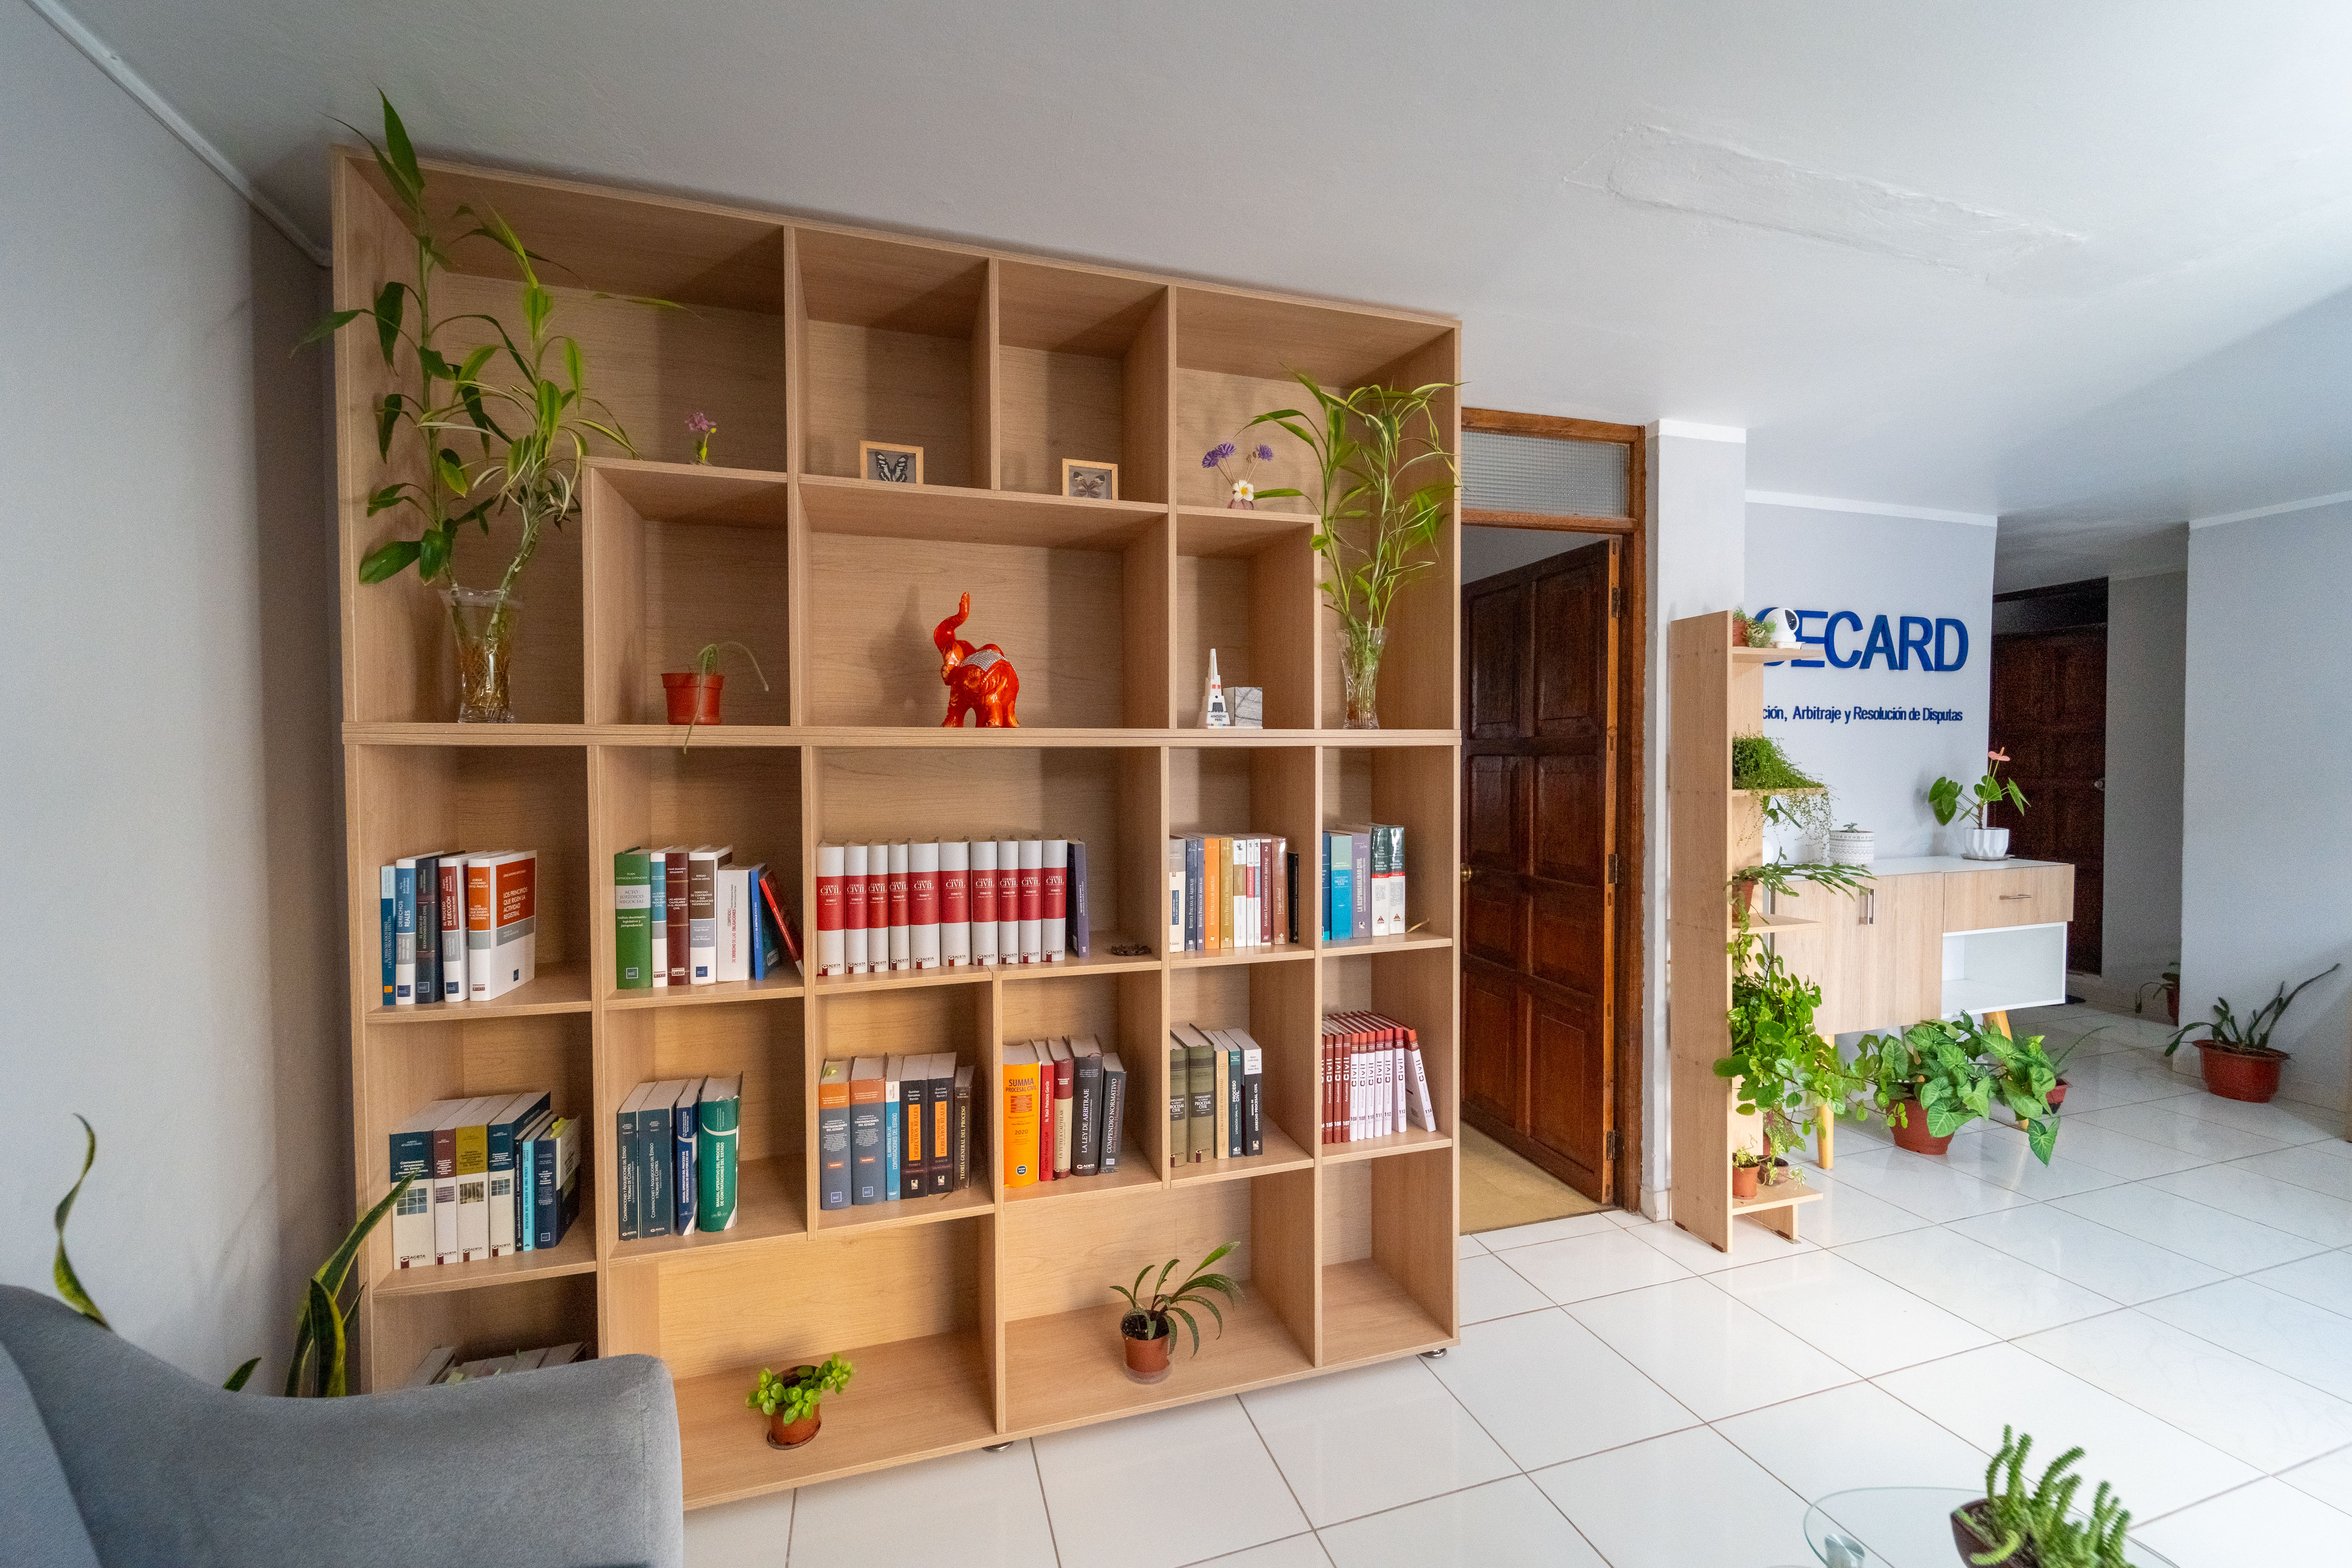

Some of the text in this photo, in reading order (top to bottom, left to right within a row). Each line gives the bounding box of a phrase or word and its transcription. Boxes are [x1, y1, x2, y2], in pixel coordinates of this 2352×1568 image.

[1793, 706, 1841, 723] Arbitraje
[1845, 710, 1851, 724] y
[1854, 707, 1907, 720] Resolución
[1909, 708, 1920, 720] de
[1923, 708, 1963, 724] Disputas
[510, 887, 528, 896] PRINCIPIOS
[504, 903, 520, 913] ACTIVIDAD
[504, 910, 520, 920] REGISTRAL
[1416, 1060, 1424, 1082] Civil
[1008, 1078, 1034, 1087] SUMMA
